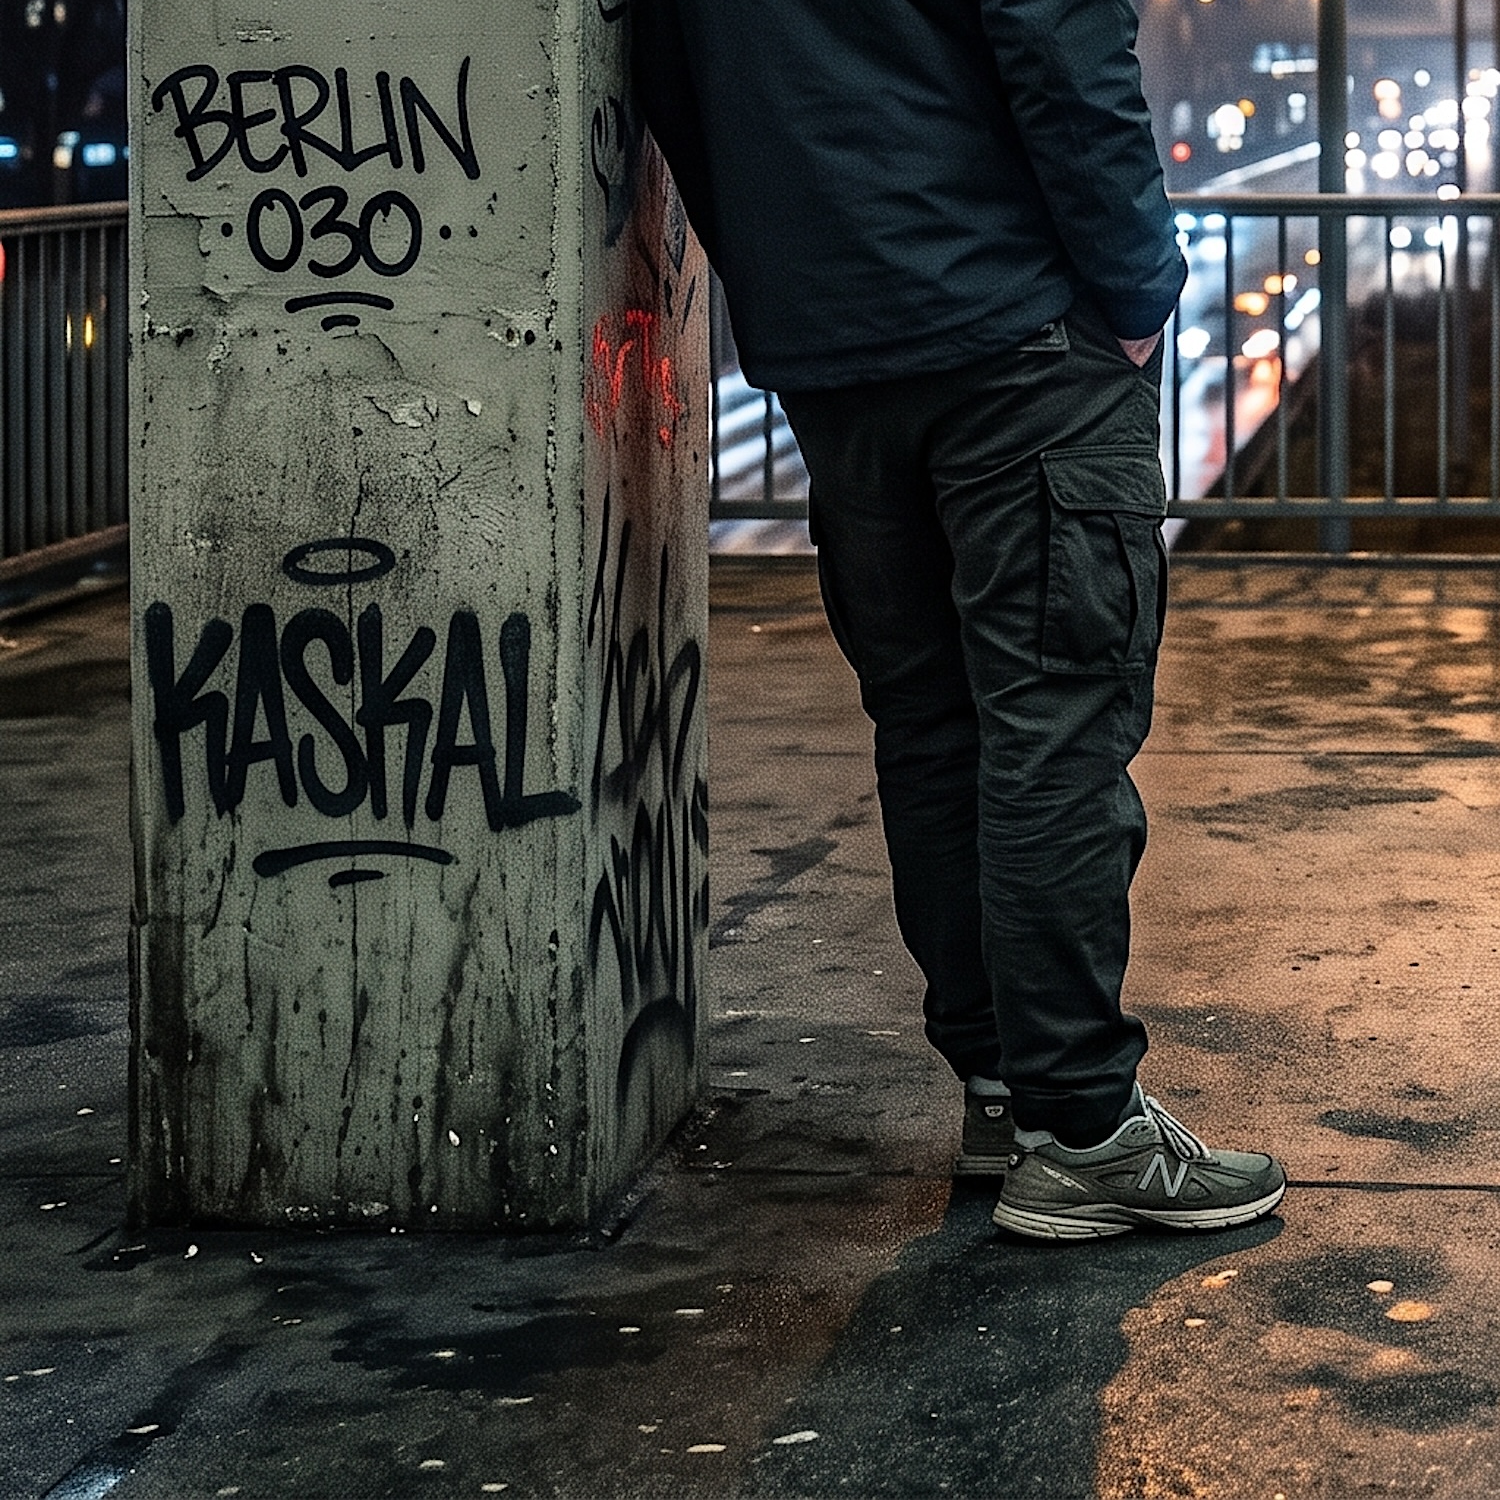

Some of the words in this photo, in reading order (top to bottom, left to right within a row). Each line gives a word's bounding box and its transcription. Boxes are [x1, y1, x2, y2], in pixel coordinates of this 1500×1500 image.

[152, 56, 480, 181] BERLIN
[144, 602, 583, 831] KASKAL
[1138, 1153, 1188, 1198] N
